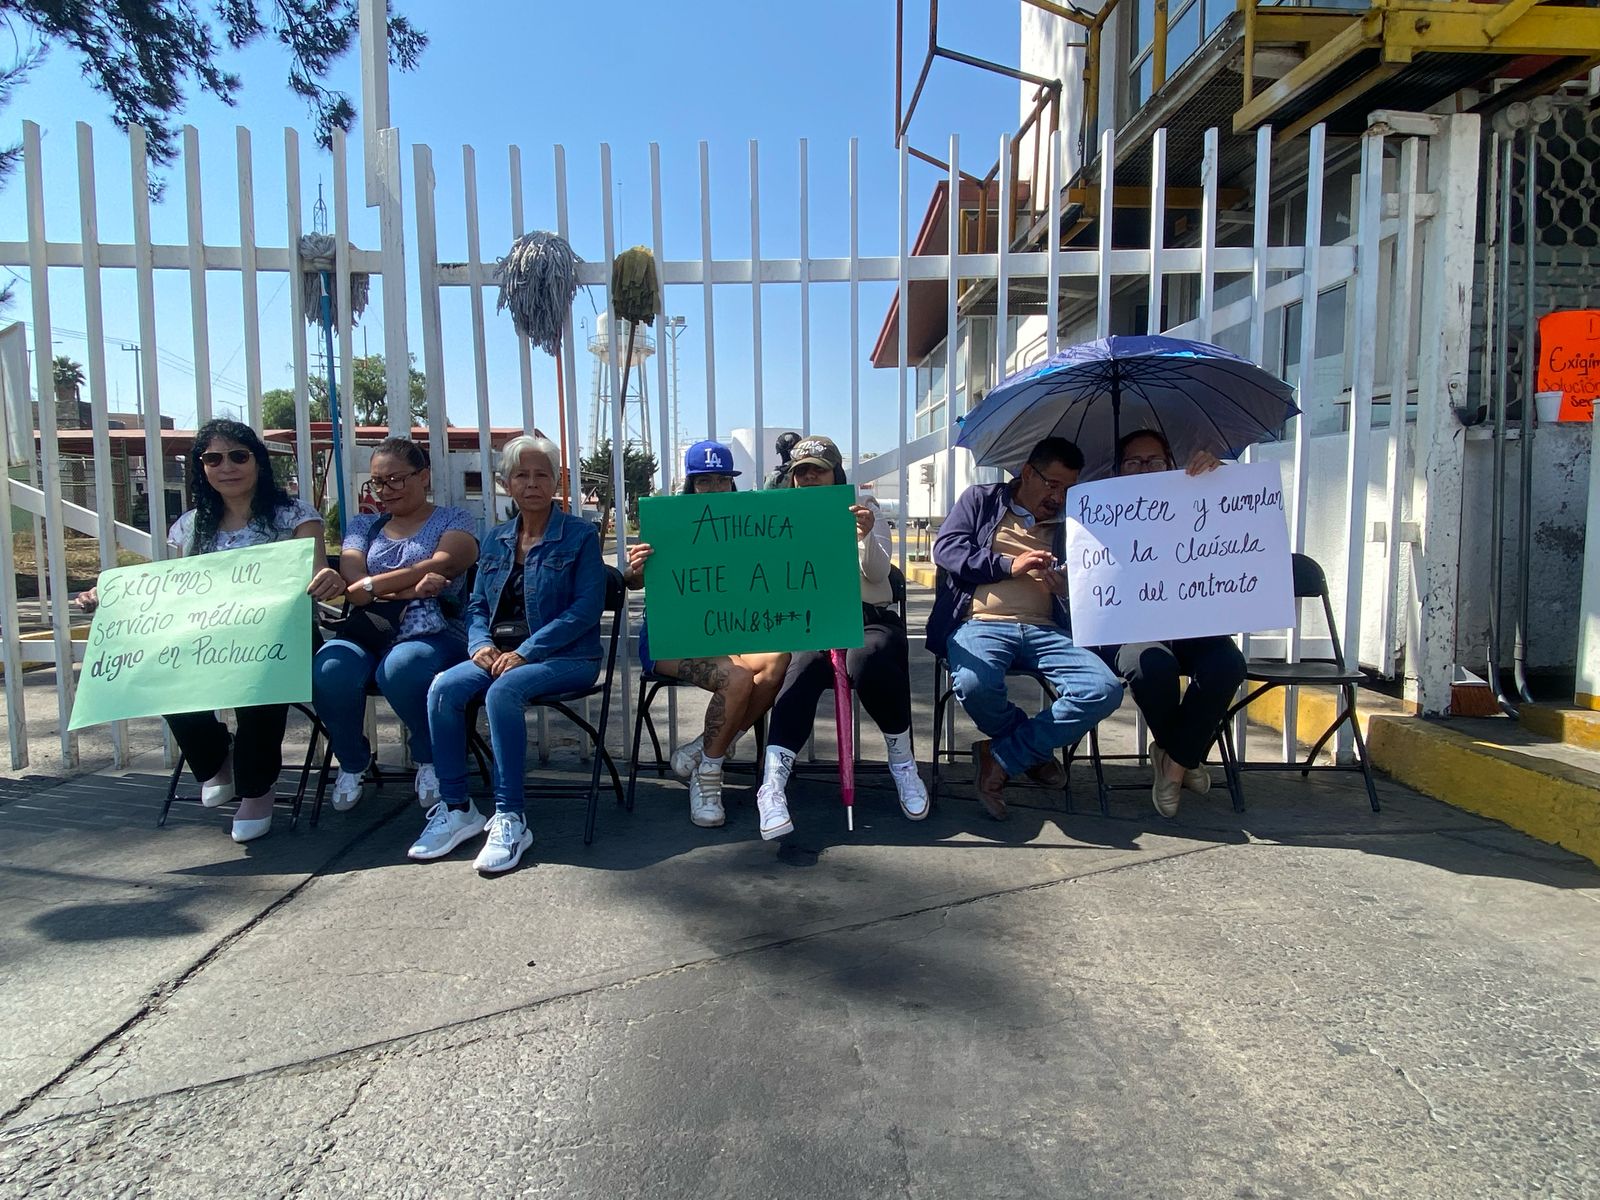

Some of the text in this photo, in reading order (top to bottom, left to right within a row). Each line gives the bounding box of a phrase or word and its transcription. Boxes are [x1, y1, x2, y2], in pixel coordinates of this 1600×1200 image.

[704, 448, 723, 468] LA
[692, 503, 795, 545] ATHENEA
[1079, 486, 1284, 532] Respeten y cumplan
[1082, 546, 1116, 569] con
[1129, 539, 1159, 563] la
[231, 561, 263, 585] un
[671, 560, 818, 596] VETE A LA
[1092, 572, 1258, 607] 92 del contrato
[93, 600, 266, 647] servicio médico
[90, 634, 288, 682] digno en Pachuca
